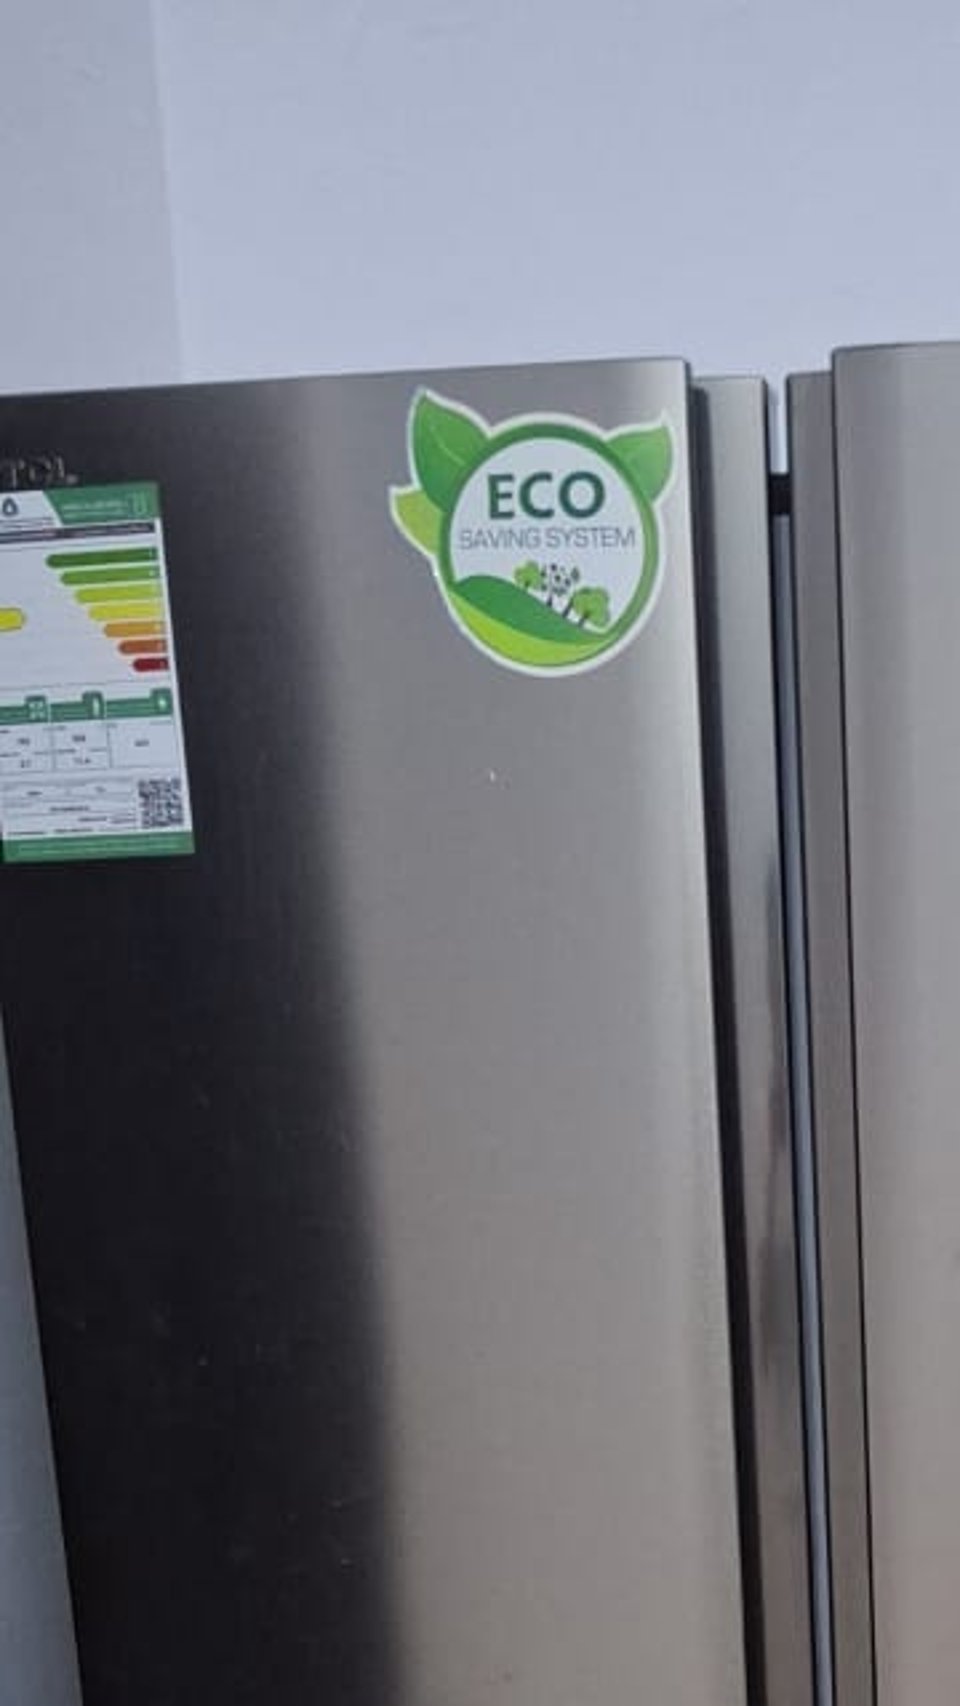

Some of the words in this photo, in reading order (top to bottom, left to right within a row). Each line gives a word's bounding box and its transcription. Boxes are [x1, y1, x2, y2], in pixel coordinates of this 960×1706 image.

[487, 470, 606, 520] ECO
[458, 527, 542, 550] SAVING
[545, 525, 637, 549] SYSTEM
